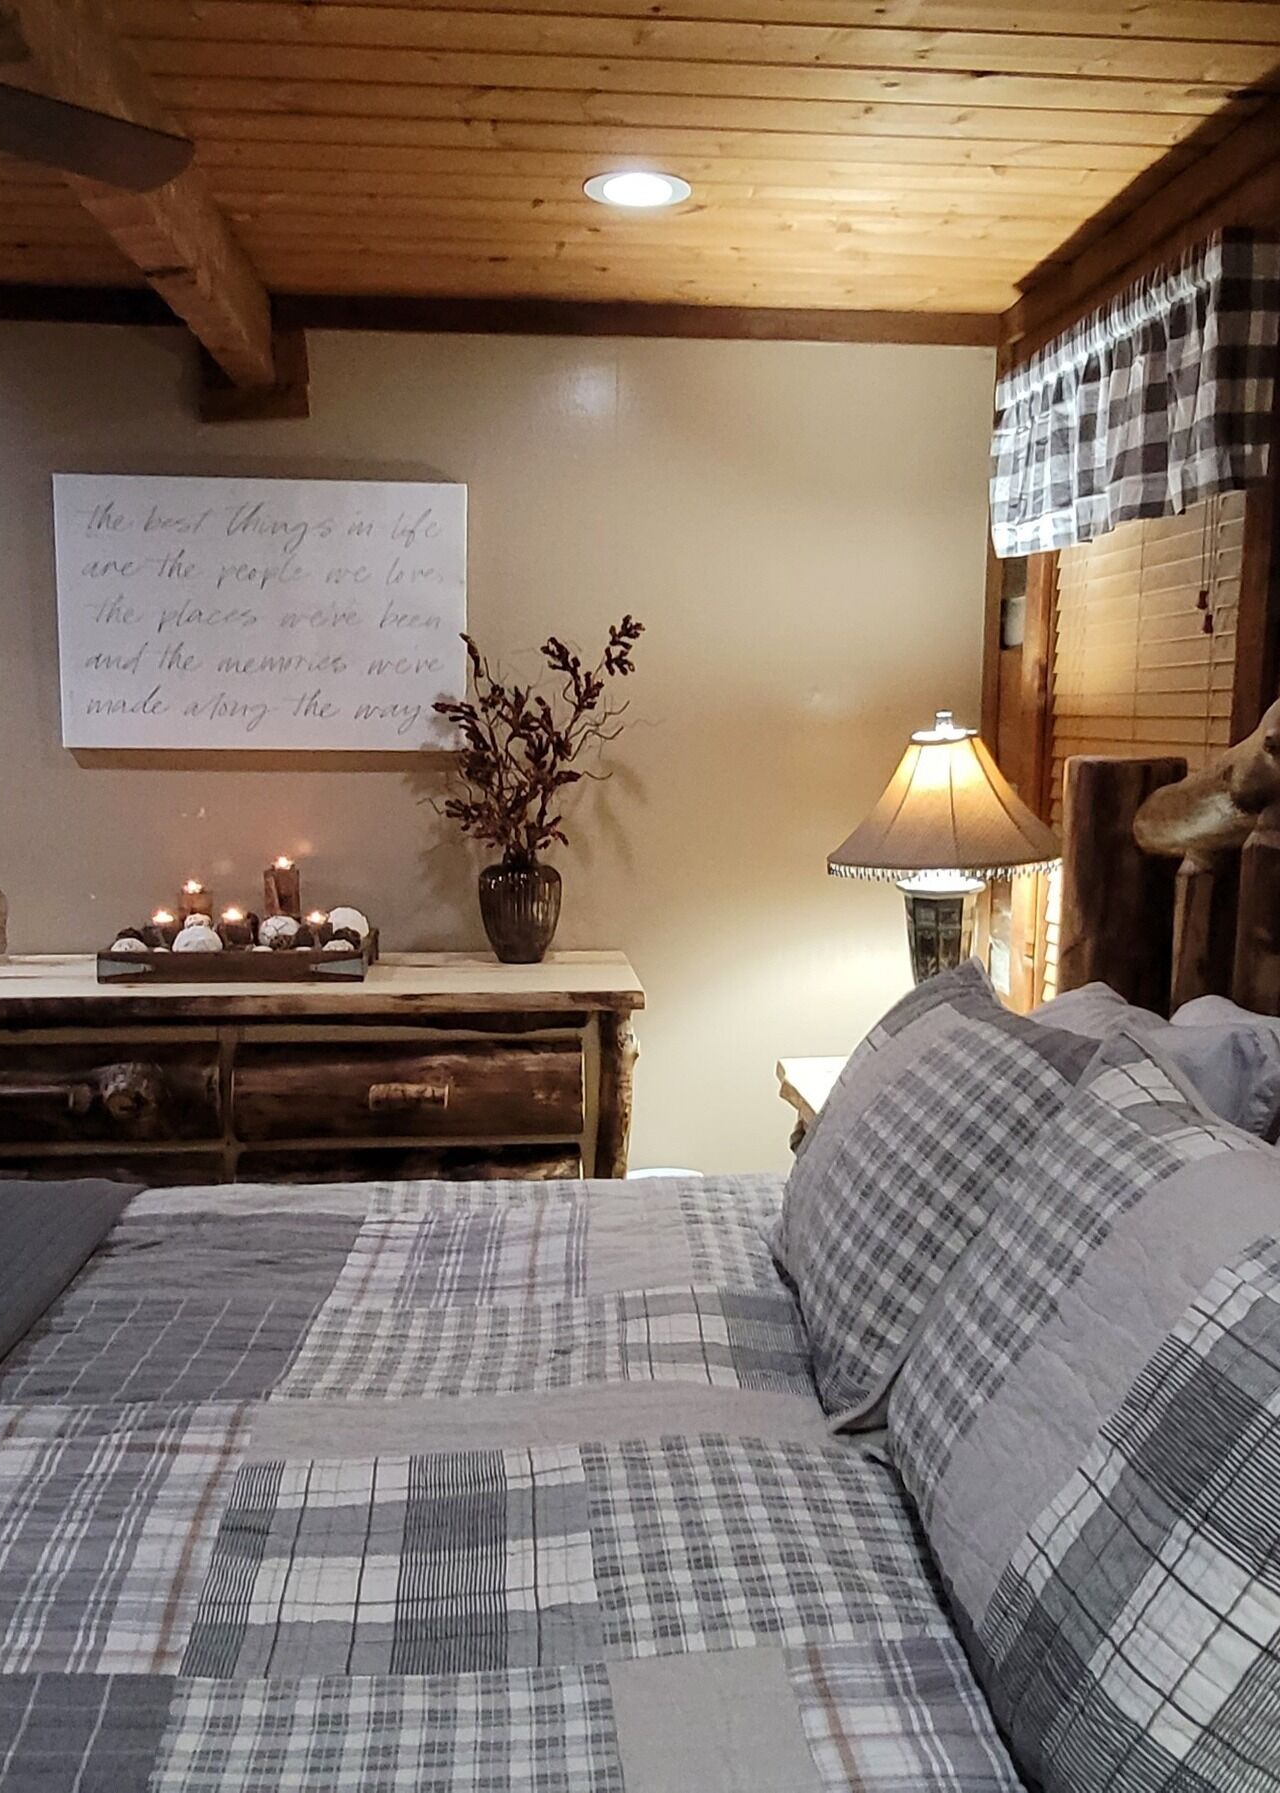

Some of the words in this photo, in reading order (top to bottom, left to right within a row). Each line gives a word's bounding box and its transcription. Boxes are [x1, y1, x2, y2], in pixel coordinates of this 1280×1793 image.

[76, 501, 133, 532] the
[143, 504, 214, 533] best
[225, 501, 335, 553] things
[346, 510, 376, 537] in
[391, 507, 442, 548] life
[81, 559, 144, 579] are
[147, 549, 200, 578] the
[216, 553, 310, 590] people
[325, 564, 370, 584] we
[83, 595, 142, 624] the
[84, 640, 150, 674] and
[148, 640, 202, 670] the
[217, 654, 348, 674] memories
[86, 683, 168, 714] made
[183, 691, 275, 732] along
[282, 688, 341, 718] the
